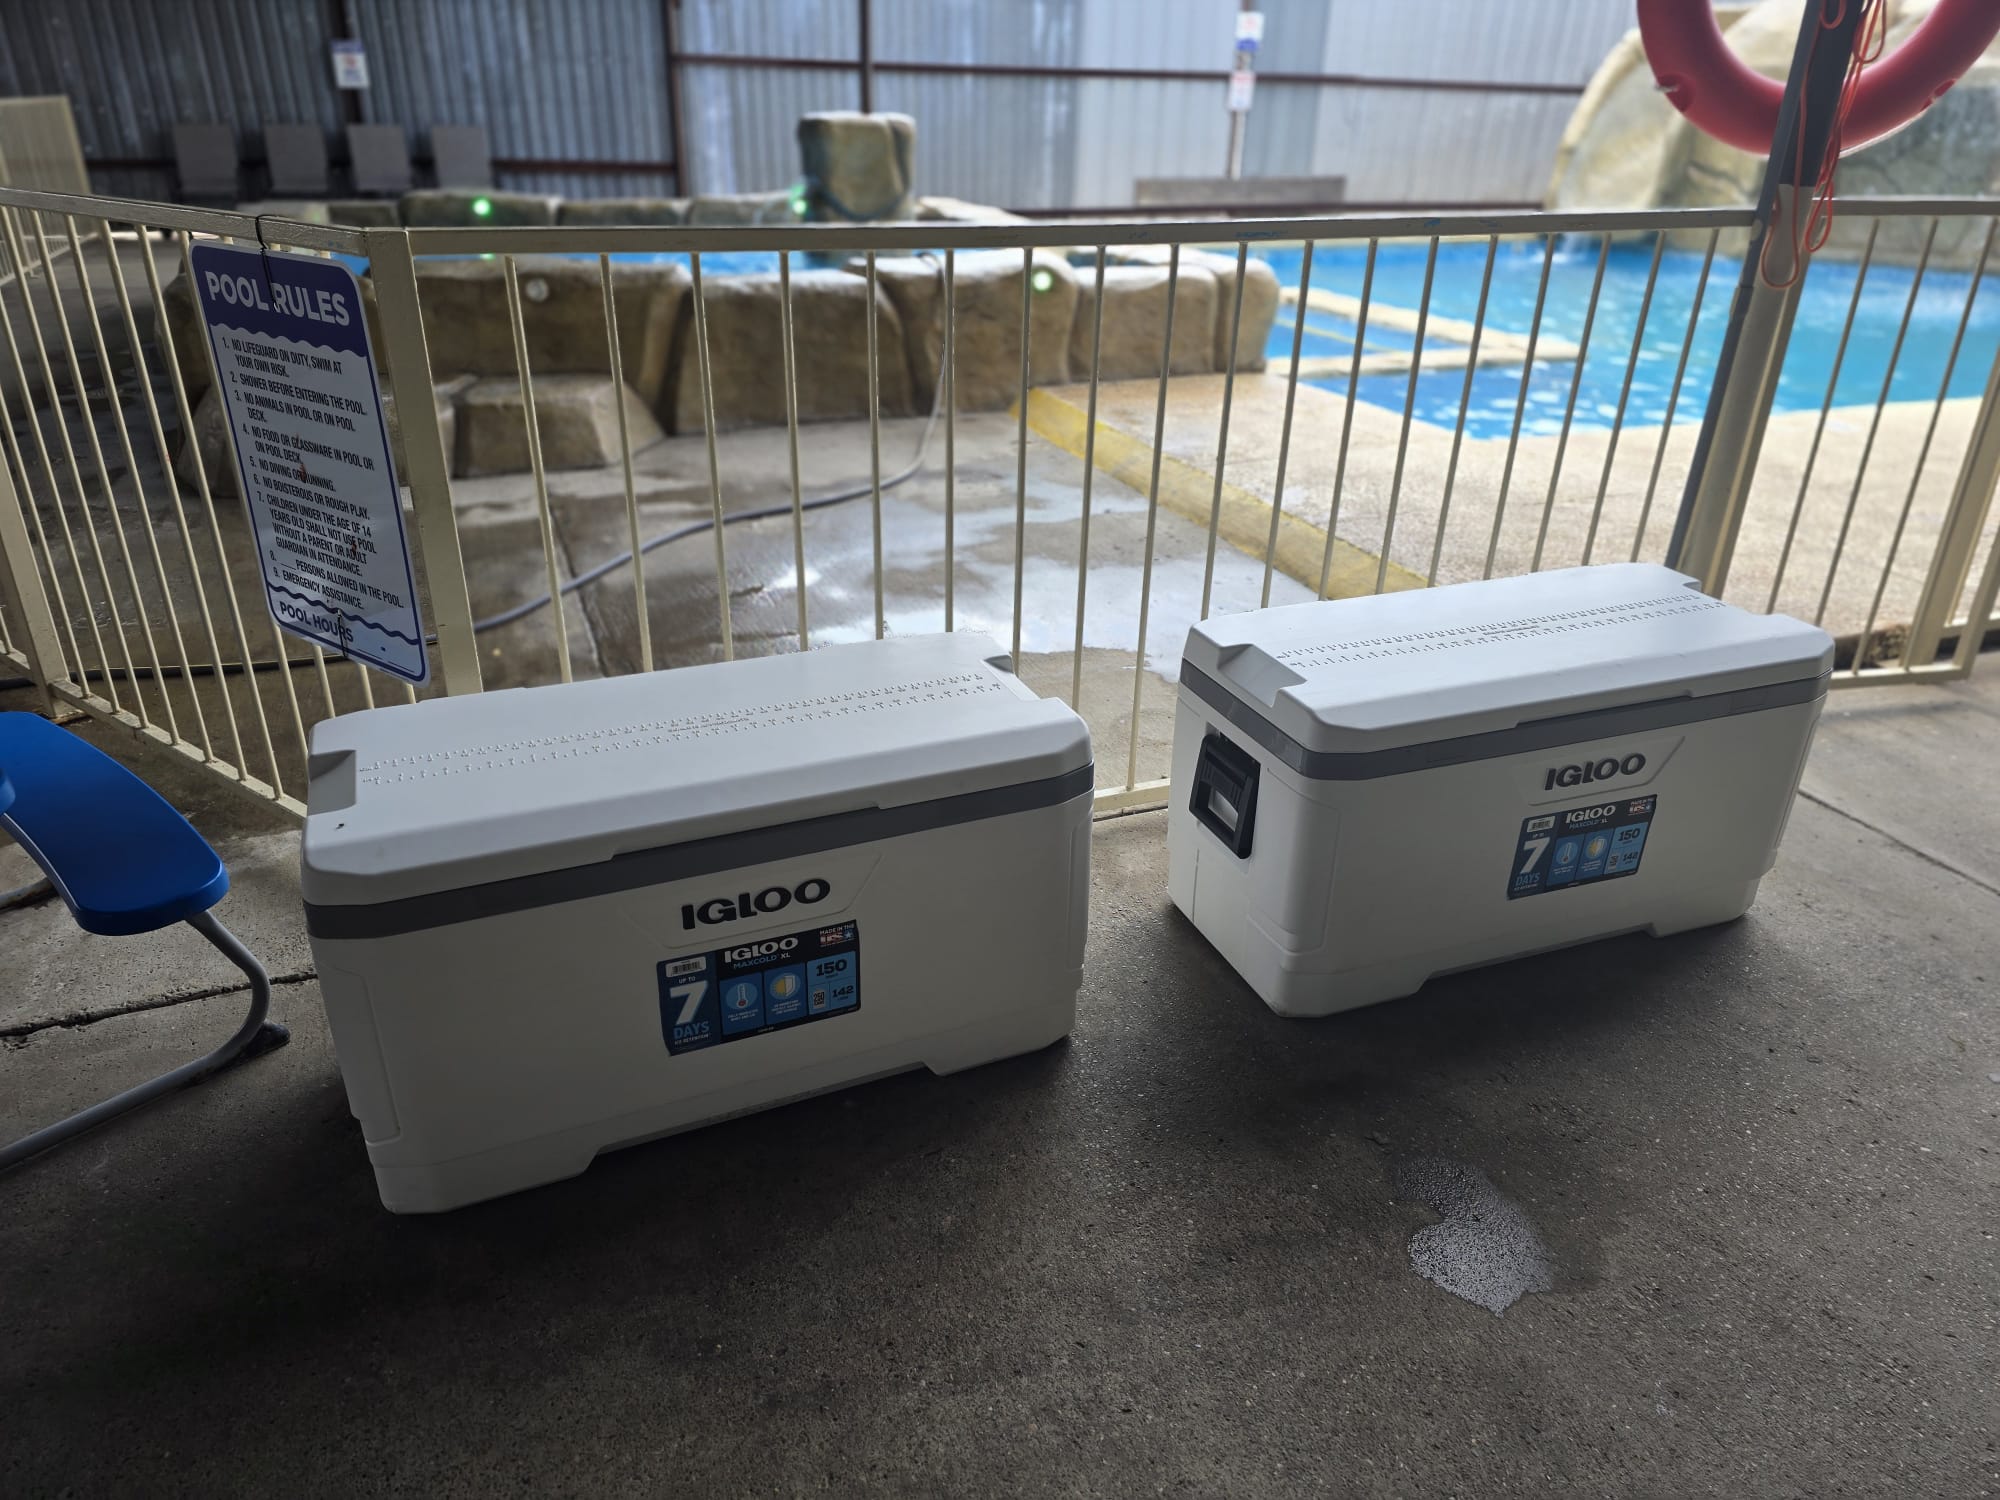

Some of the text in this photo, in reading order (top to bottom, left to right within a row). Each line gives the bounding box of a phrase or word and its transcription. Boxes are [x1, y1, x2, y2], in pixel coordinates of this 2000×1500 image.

[205, 271, 350, 326] POOL RULES
[231, 339, 242, 351] NO
[241, 341, 278, 359] LIFEGUARD
[278, 349, 289, 362] ON
[310, 356, 332, 371] SWIM
[332, 361, 343, 374] AT
[235, 354, 254, 369] YOUR
[253, 358, 270, 373] OWN
[229, 371, 237, 383] 2.
[239, 373, 267, 390] SHOWER
[267, 380, 295, 397] BEFORE
[294, 387, 329, 406] ENTERING
[329, 395, 344, 410] THE
[243, 392, 254, 404] NO
[253, 394, 284, 412] ANIMALS
[284, 402, 293, 415] IN
[293, 404, 312, 420] POOL
[312, 409, 323, 422] OR
[323, 412, 335, 425] ON
[334, 415, 356, 431] POOL
[251, 425, 262, 438] NO
[261, 428, 280, 443] FOOD
[279, 433, 291, 446] OR
[332, 448, 342, 461] IN
[342, 450, 362, 467] POOL
[362, 456, 375, 470] OR
[254, 440, 264, 452] ON
[264, 443, 282, 458] POOL
[249, 456, 256, 467] 5.
[258, 458, 269, 471] NO
[268, 462, 292, 478] DIVING
[253, 473, 260, 485] 6.
[262, 476, 273, 489] NO
[272, 479, 313, 502] BOISTEROUS
[313, 492, 324, 505] OR
[324, 495, 349, 513] ROUGH
[256, 491, 372, 538] 7. CHILDREN UNDER THE AGE OF 14
[269, 508, 291, 525] YEARS
[290, 515, 305, 529] OLD
[305, 520, 326, 537] SHALL
[326, 527, 342, 542] NOT
[357, 537, 376, 553] POOL
[272, 522, 303, 542] WITHOUT
[301, 532, 306, 543] A
[307, 534, 333, 552] PARENT
[333, 542, 345, 557] OR
[275, 536, 308, 557] GUARDIAN
[308, 547, 317, 560] IN
[281, 570, 320, 593] EMERGENCY
[294, 559, 326, 580] PERSONS
[326, 570, 358, 592] ALLOWED
[358, 582, 367, 595] IN
[367, 585, 382, 600] THE
[280, 601, 353, 642] POOL HOURS
[1545, 753, 1646, 790] IGLOO
[1566, 805, 1616, 823] IGLOO
[1618, 829, 1640, 841] 150
[1524, 837, 1550, 873] 7
[1515, 872, 1540, 886] DAYS
[681, 878, 831, 930] IGLOO
[819, 927, 836, 935] MADE
[724, 937, 798, 963] IGLOO
[733, 955, 777, 969] MAXCOLD
[816, 959, 847, 976] 150
[669, 980, 708, 1025] 7
[832, 985, 853, 998] 142
[673, 1021, 709, 1040] DAYS
